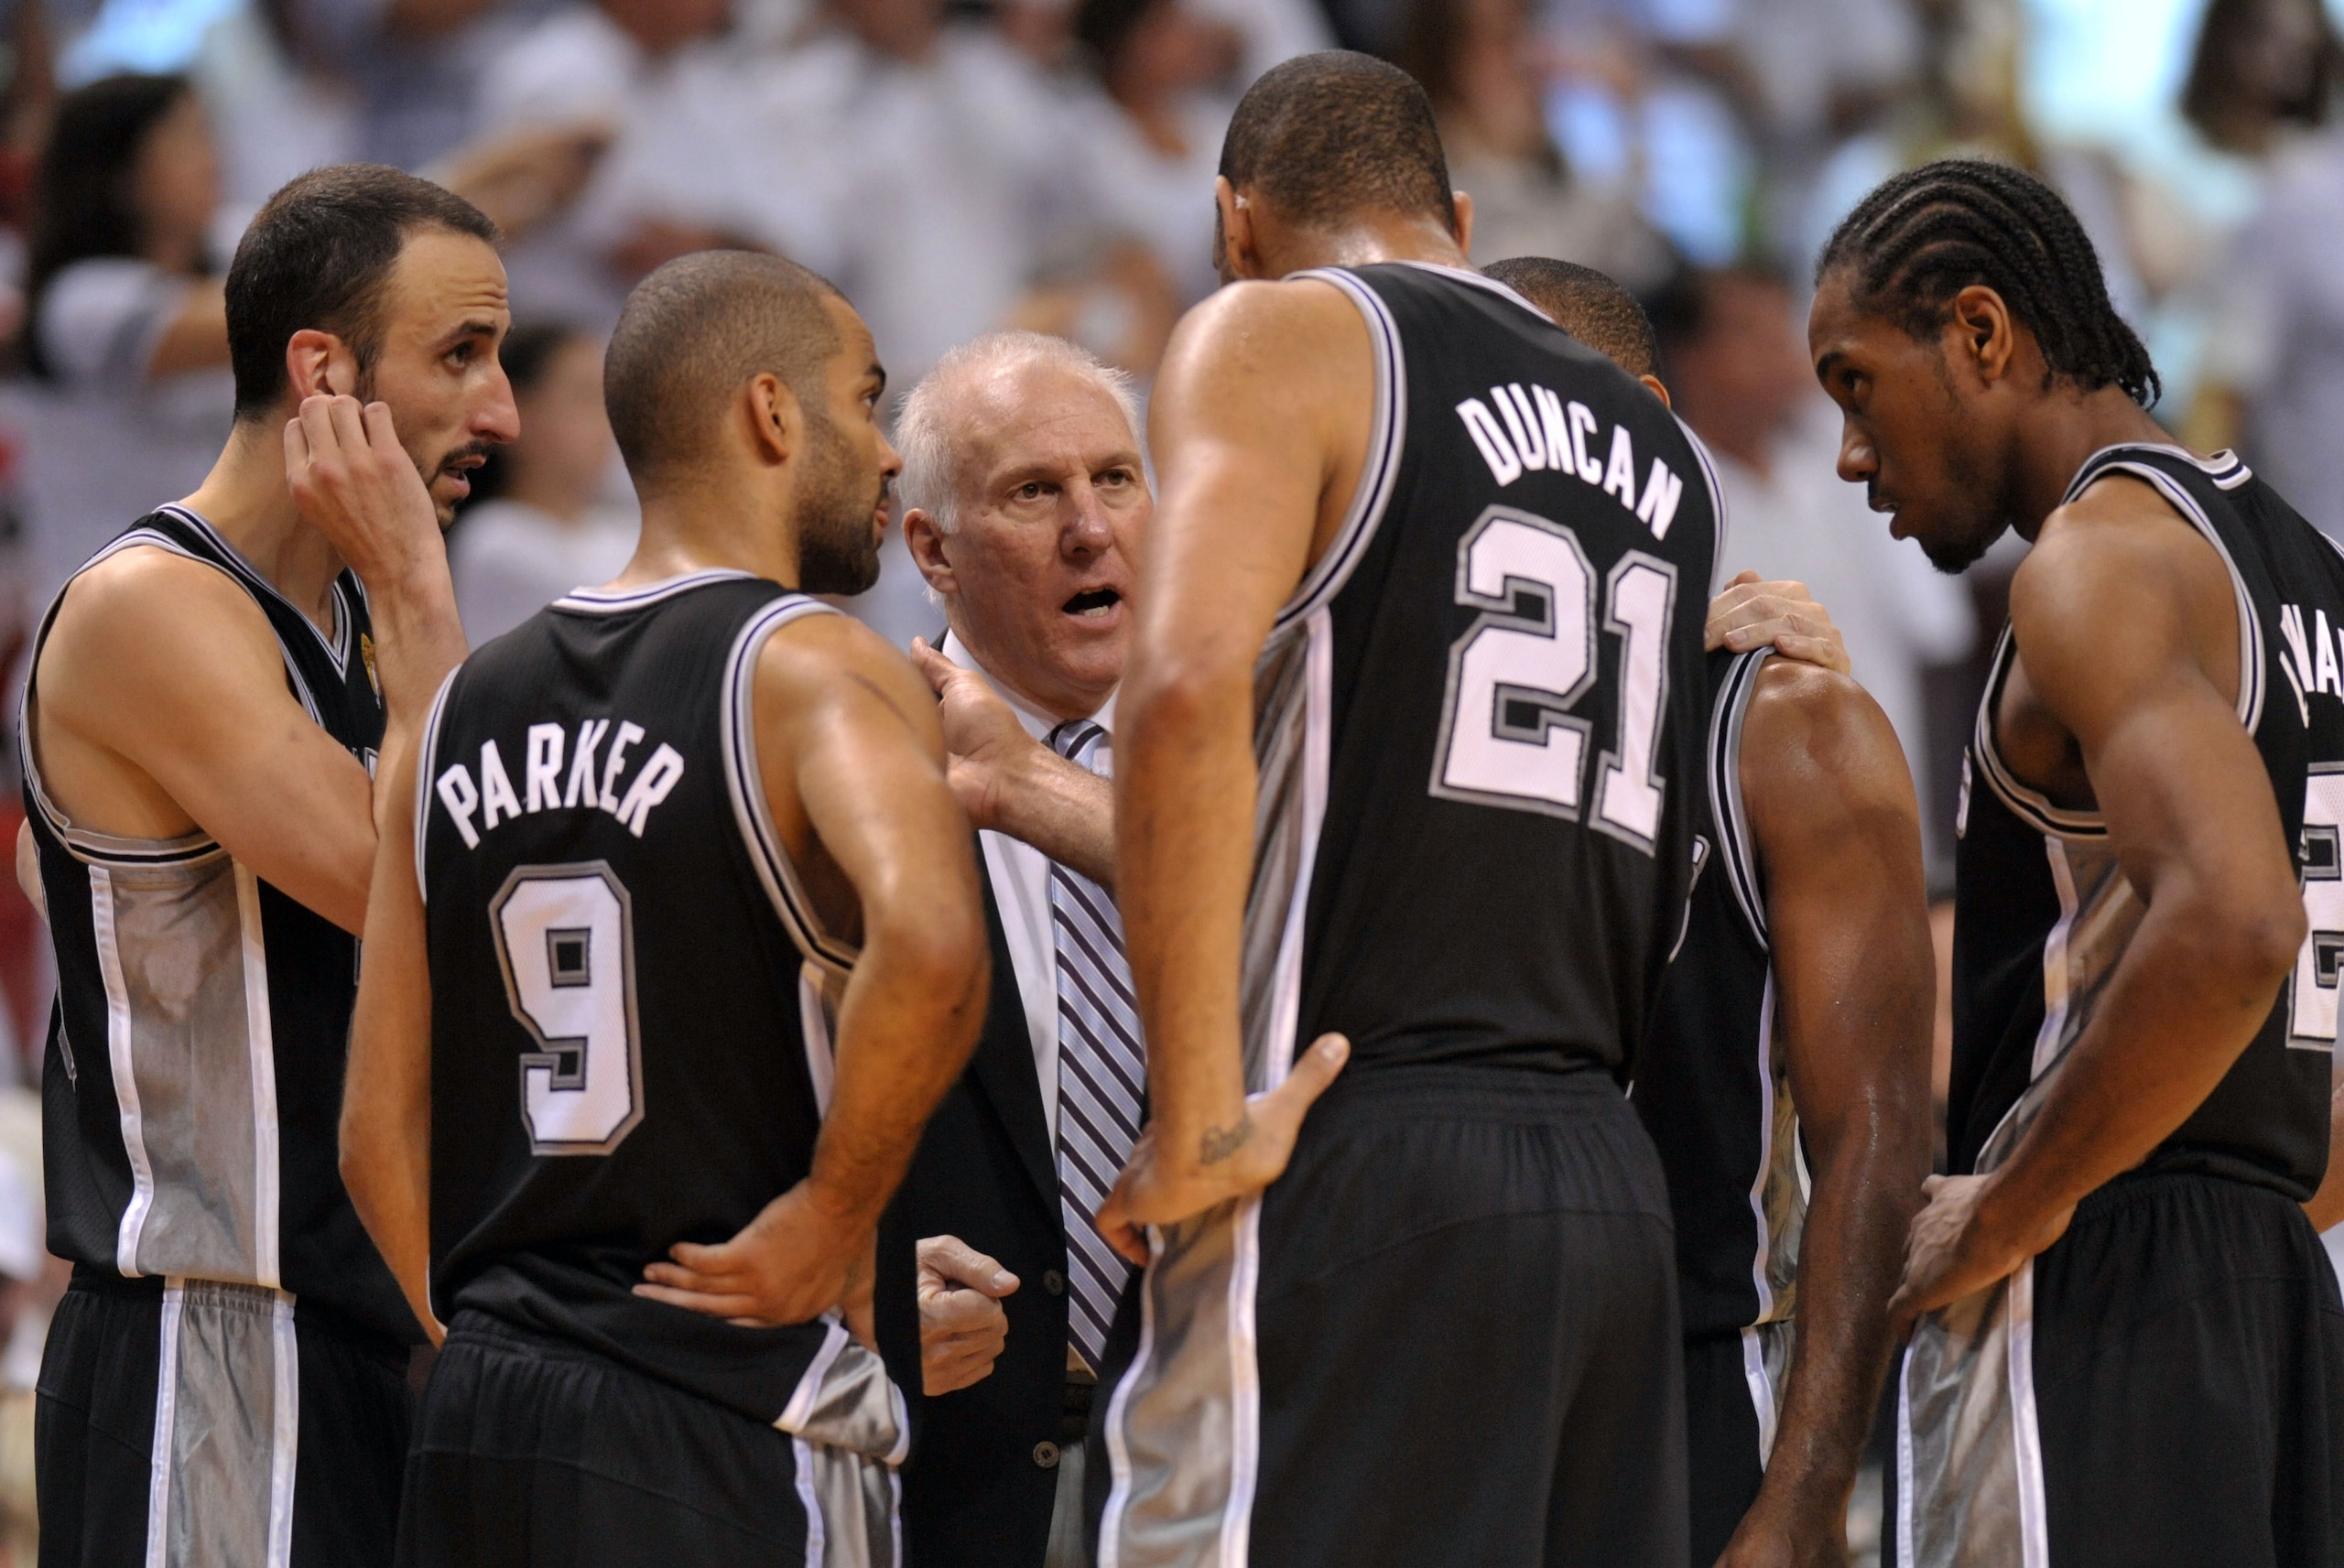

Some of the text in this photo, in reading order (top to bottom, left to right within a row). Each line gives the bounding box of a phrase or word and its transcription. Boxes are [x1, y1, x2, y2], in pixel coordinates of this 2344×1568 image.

[1455, 383, 1683, 541] DUNCAN
[436, 719, 685, 851] PARKER
[1428, 503, 1678, 859] 21
[488, 859, 645, 1156] 9
